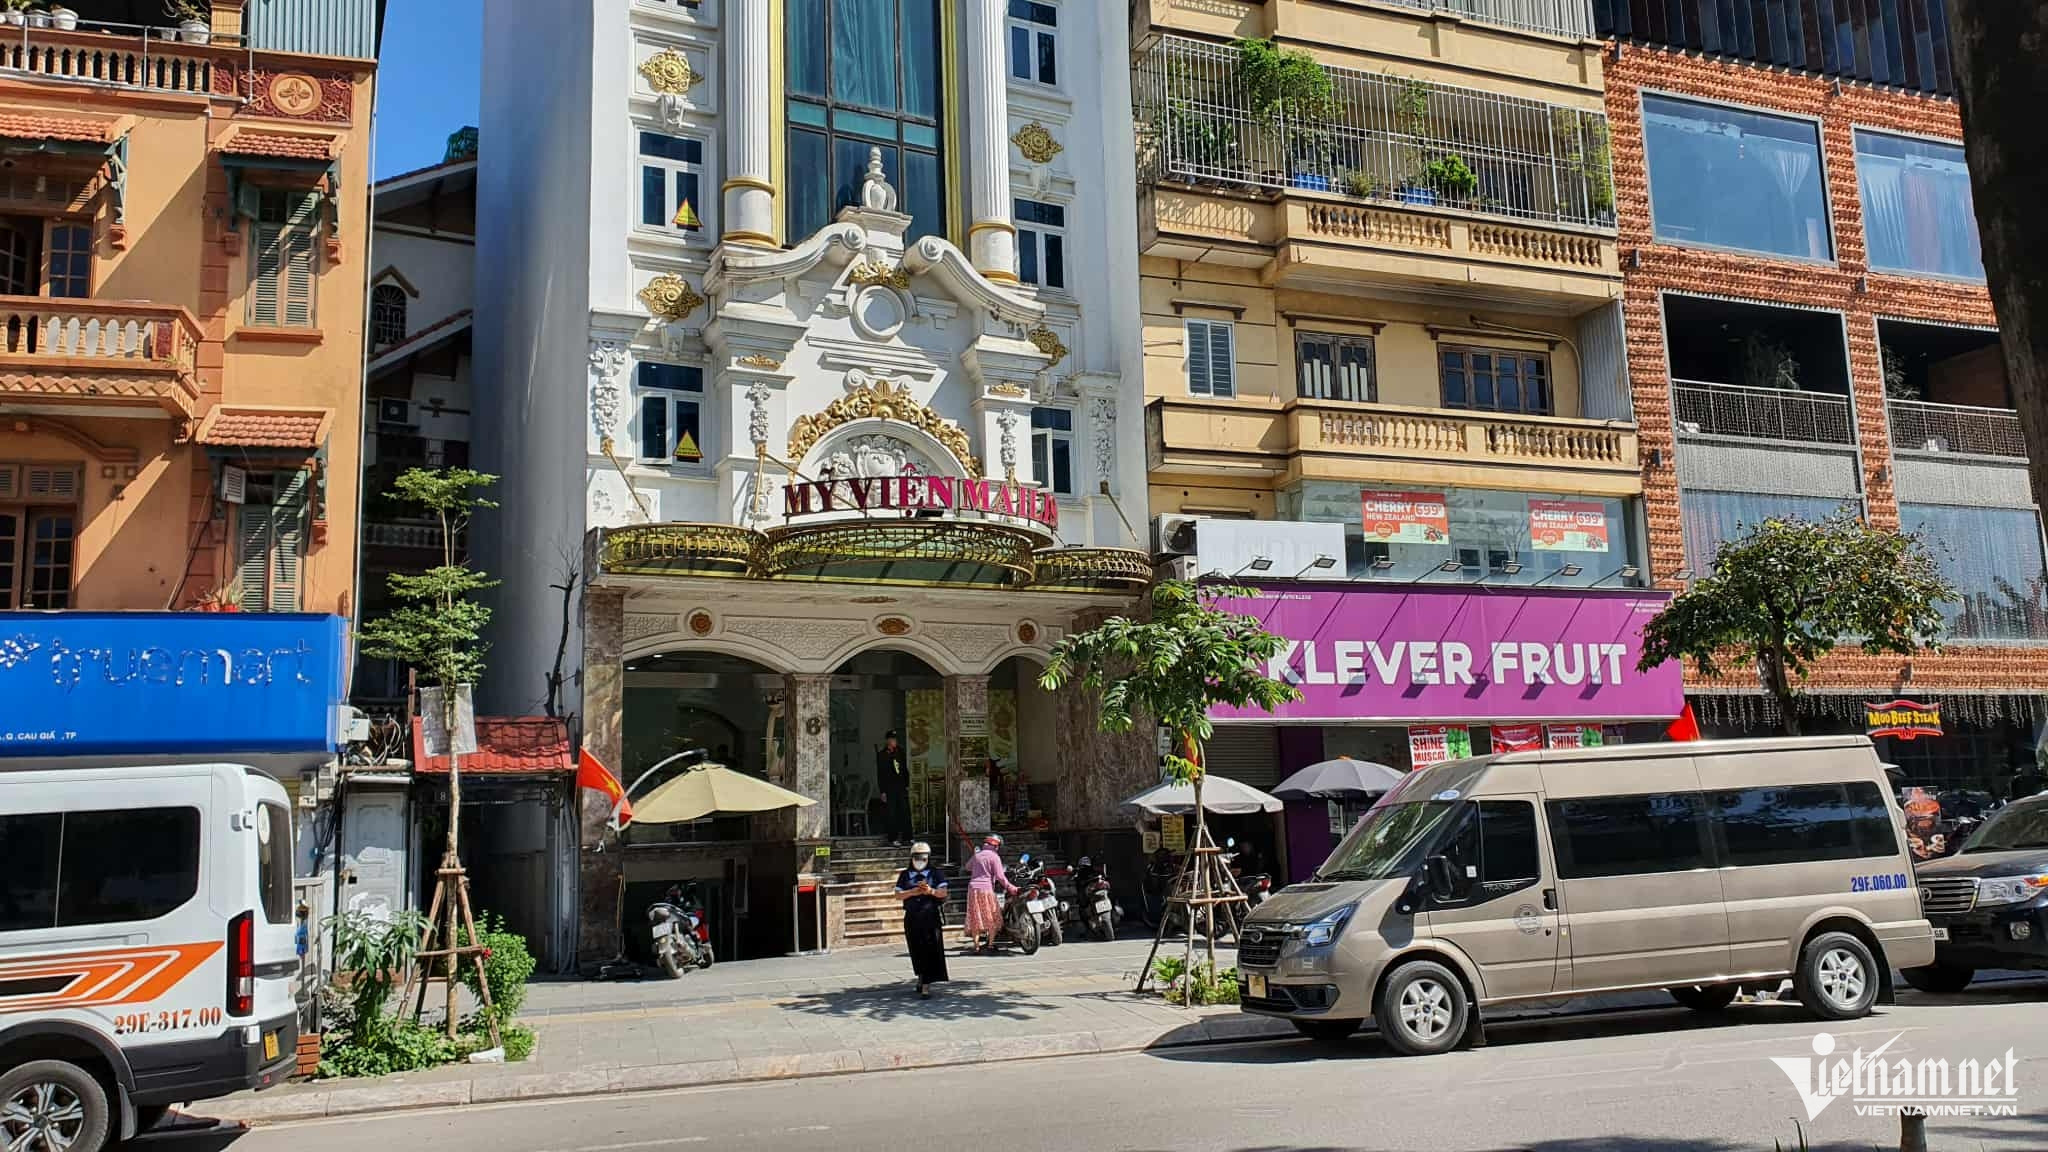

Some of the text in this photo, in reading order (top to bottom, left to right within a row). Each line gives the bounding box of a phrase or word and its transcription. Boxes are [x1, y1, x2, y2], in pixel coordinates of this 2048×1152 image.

[849, 463, 955, 518] VIỆN
[1365, 501, 1412, 513] CHERRY
[1384, 513, 1415, 521] ZEALAND
[1532, 510, 1574, 521] CHERRY
[1268, 640, 1627, 686] KLEVER FRUIT
[1413, 737, 1443, 750] SHINE
[1552, 736, 1579, 748] SHINE
[1414, 751, 1445, 761] MUSCAT
[1851, 873, 1907, 892] 29F.060.00
[114, 1006, 222, 1034] 29E-317.00
